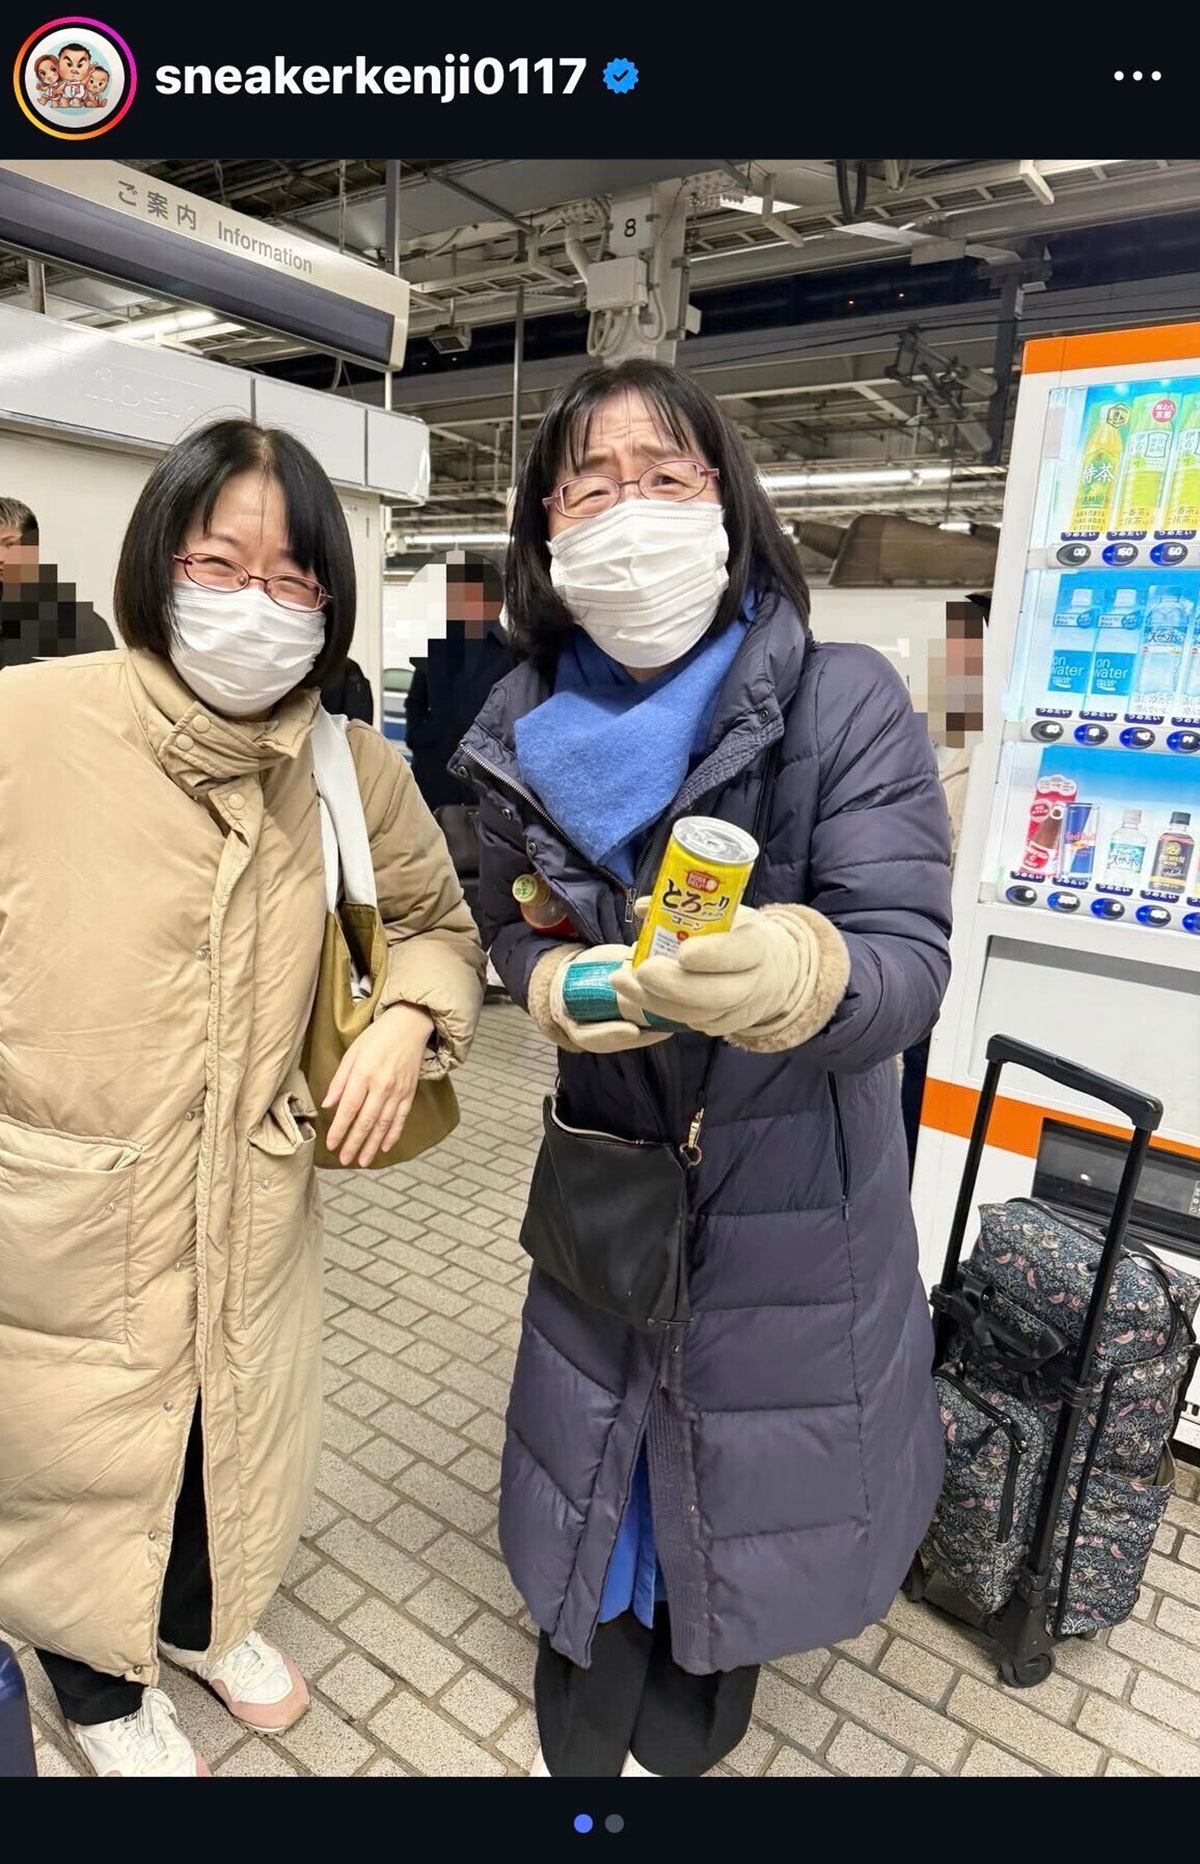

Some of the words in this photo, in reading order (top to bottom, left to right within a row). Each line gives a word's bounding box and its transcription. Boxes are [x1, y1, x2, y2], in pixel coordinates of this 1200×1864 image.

[118, 179, 198, 231] ご案内
[218, 220, 313, 275] Information
[623, 218, 638, 238] 8
[671, 914, 706, 931] コーン
